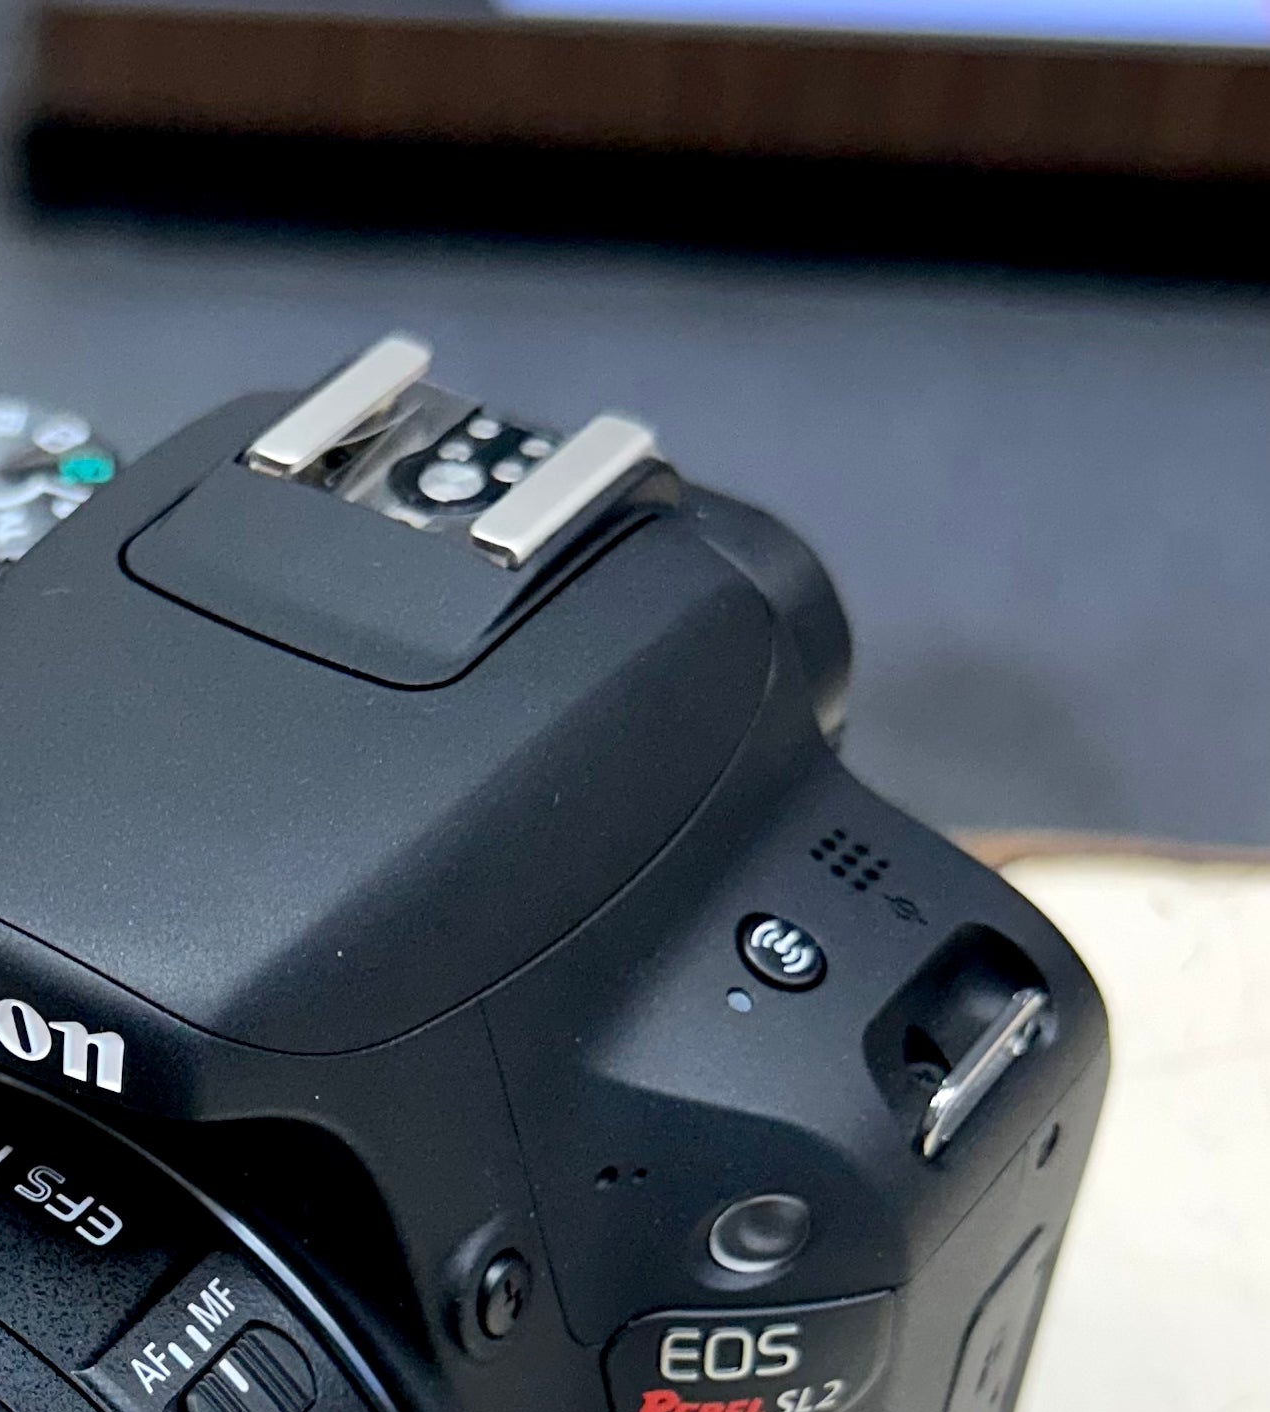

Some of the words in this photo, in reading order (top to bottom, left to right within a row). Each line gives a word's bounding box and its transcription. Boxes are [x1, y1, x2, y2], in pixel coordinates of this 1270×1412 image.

[130, 1341, 172, 1394] AF
[186, 1277, 236, 1332] MF
[660, 1322, 801, 1382] EOS
